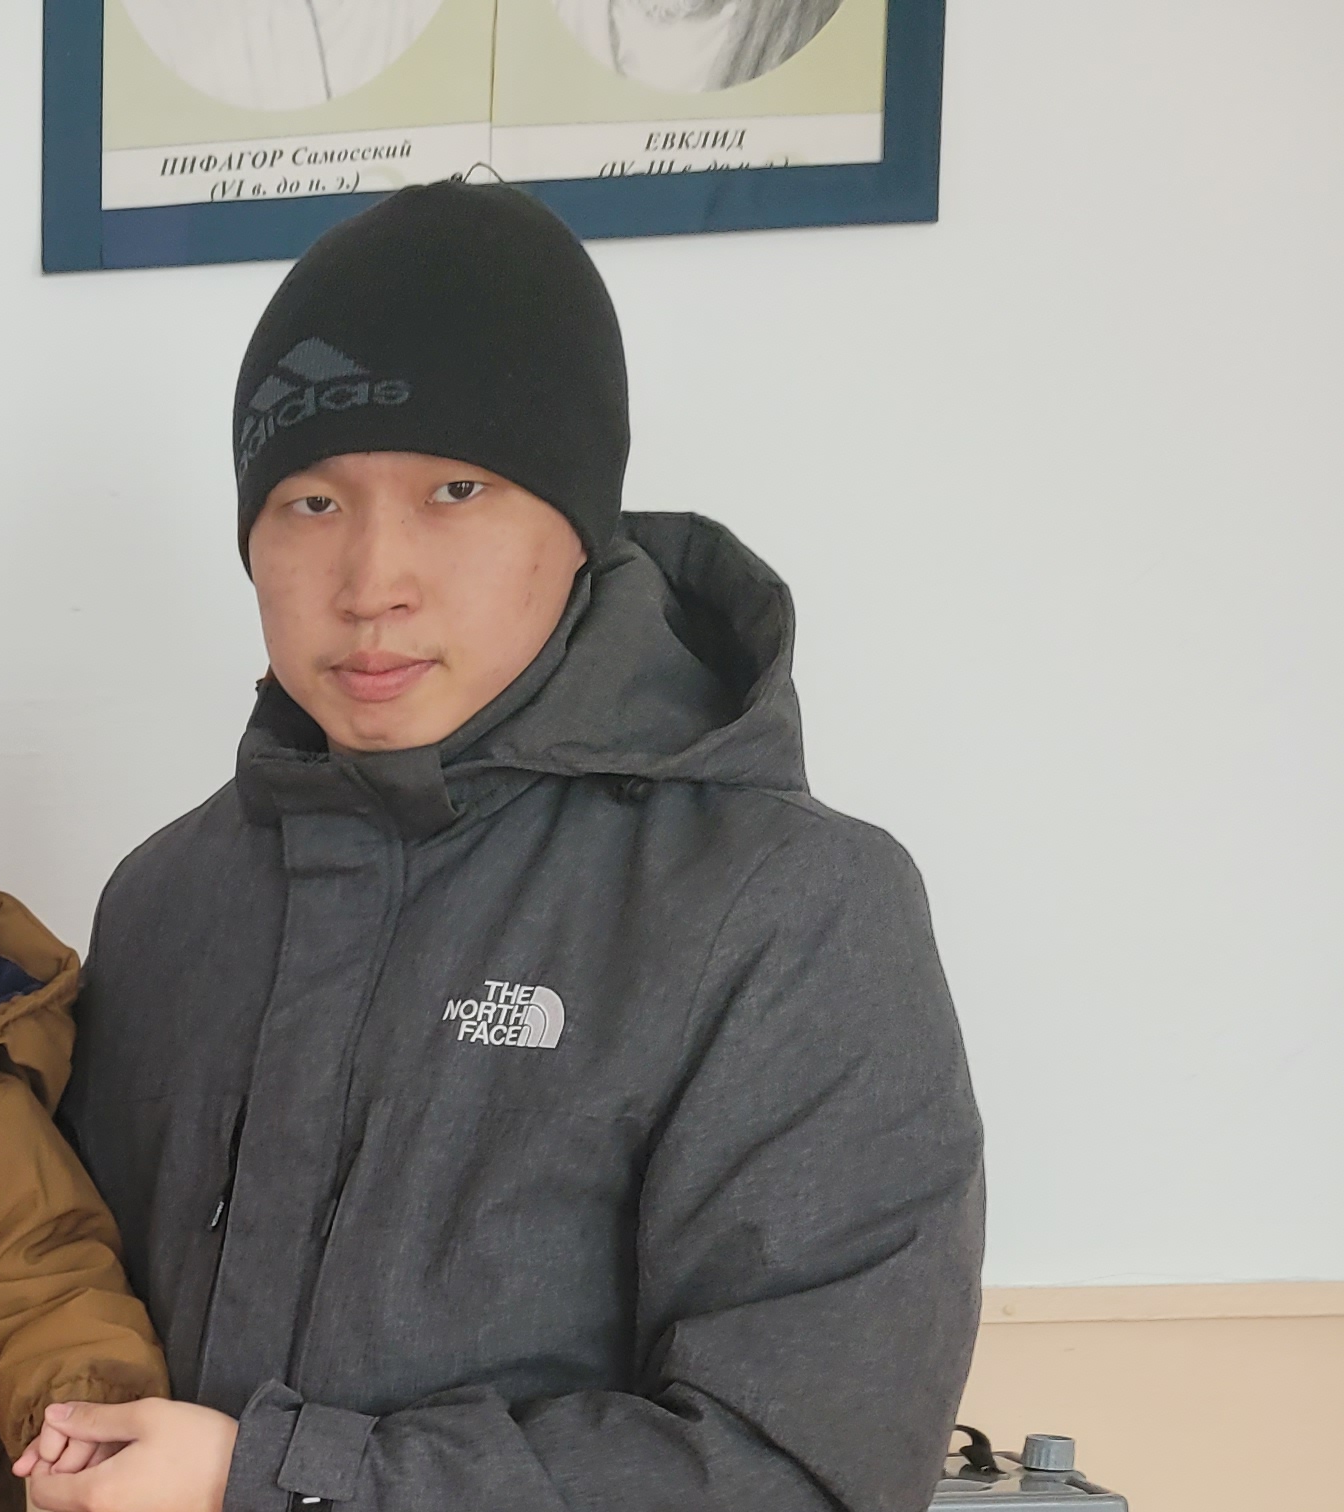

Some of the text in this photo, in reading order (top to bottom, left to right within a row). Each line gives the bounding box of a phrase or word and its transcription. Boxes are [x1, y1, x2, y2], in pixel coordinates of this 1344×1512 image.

[644, 129, 747, 151] ЕВКЛИД
[160, 139, 412, 176] ПИФАГОР Самосский
[210, 180, 245, 201] (VI
[276, 176, 300, 194] до
[483, 979, 535, 1005] THE
[442, 998, 530, 1026] NORTH
[457, 1020, 523, 1047] FACE
